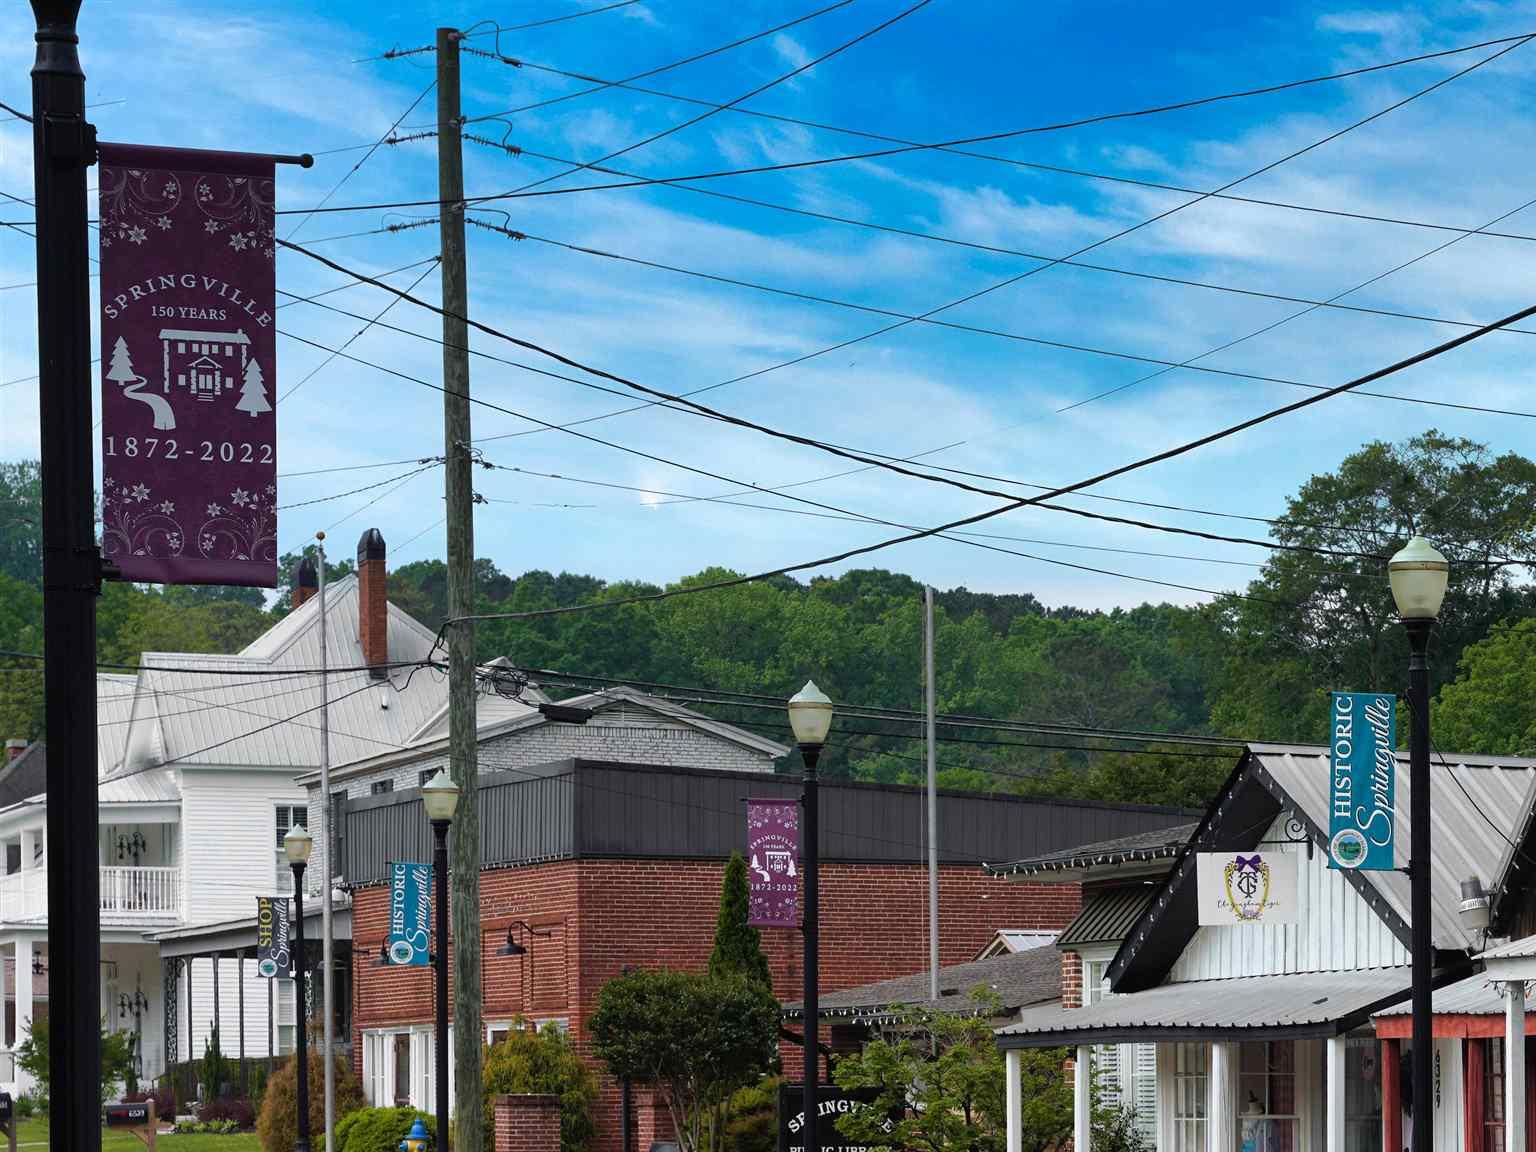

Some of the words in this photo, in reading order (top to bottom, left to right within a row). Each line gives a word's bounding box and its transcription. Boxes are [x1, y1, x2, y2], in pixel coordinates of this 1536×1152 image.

[104, 273, 273, 328] SPRINGVILLE
[151, 305, 175, 318] 150
[179, 306, 227, 321] YEARS
[104, 435, 274, 465] 1872-2022
[1333, 695, 1353, 818] HISTORIC
[1355, 696, 1398, 847] Springville
[749, 834, 798, 851] SPRINGVILLE
[392, 864, 406, 935] HISTORIC
[406, 866, 432, 952] Springville
[750, 882, 798, 892] 1872-2022
[259, 898, 273, 948] SHOP
[271, 899, 290, 968] Springville
[787, 1099, 894, 1134] SPINGVE
